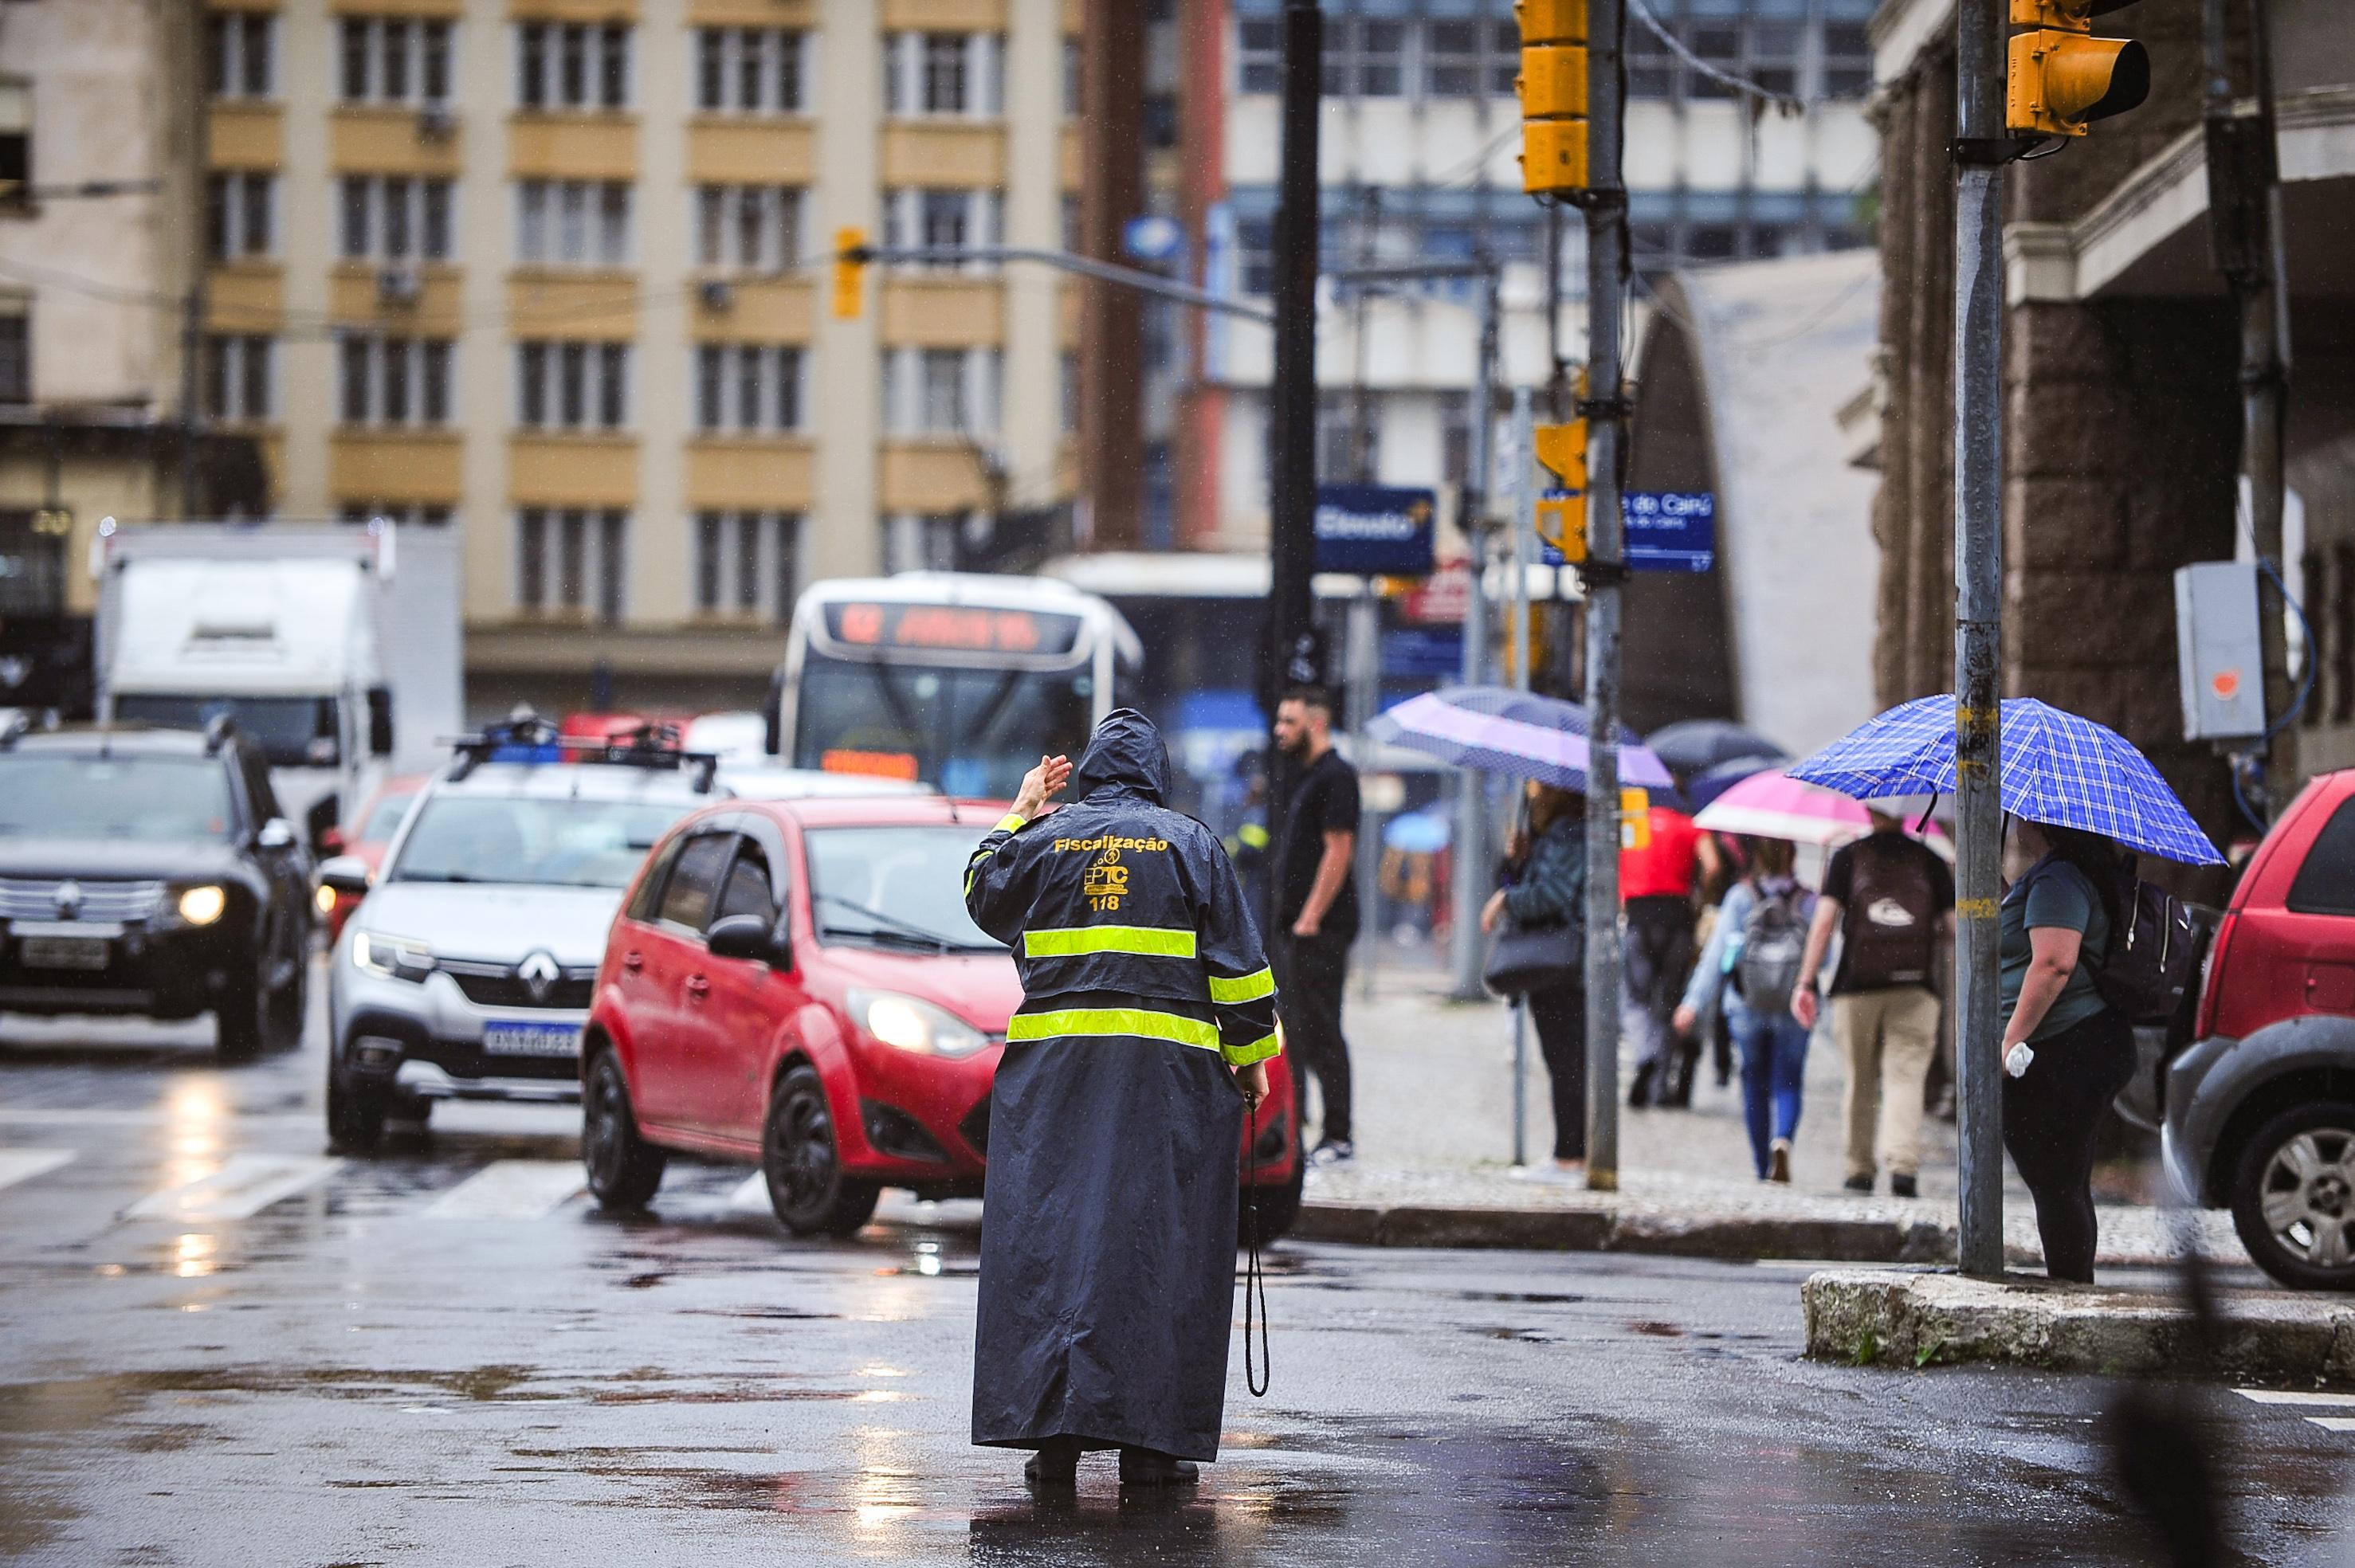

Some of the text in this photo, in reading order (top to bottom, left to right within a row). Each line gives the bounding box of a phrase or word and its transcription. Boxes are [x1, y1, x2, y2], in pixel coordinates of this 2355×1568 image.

[1054, 835, 1168, 853] Fiscalização
[1085, 866, 1128, 884] EPTC
[1089, 895, 1120, 911] 118
